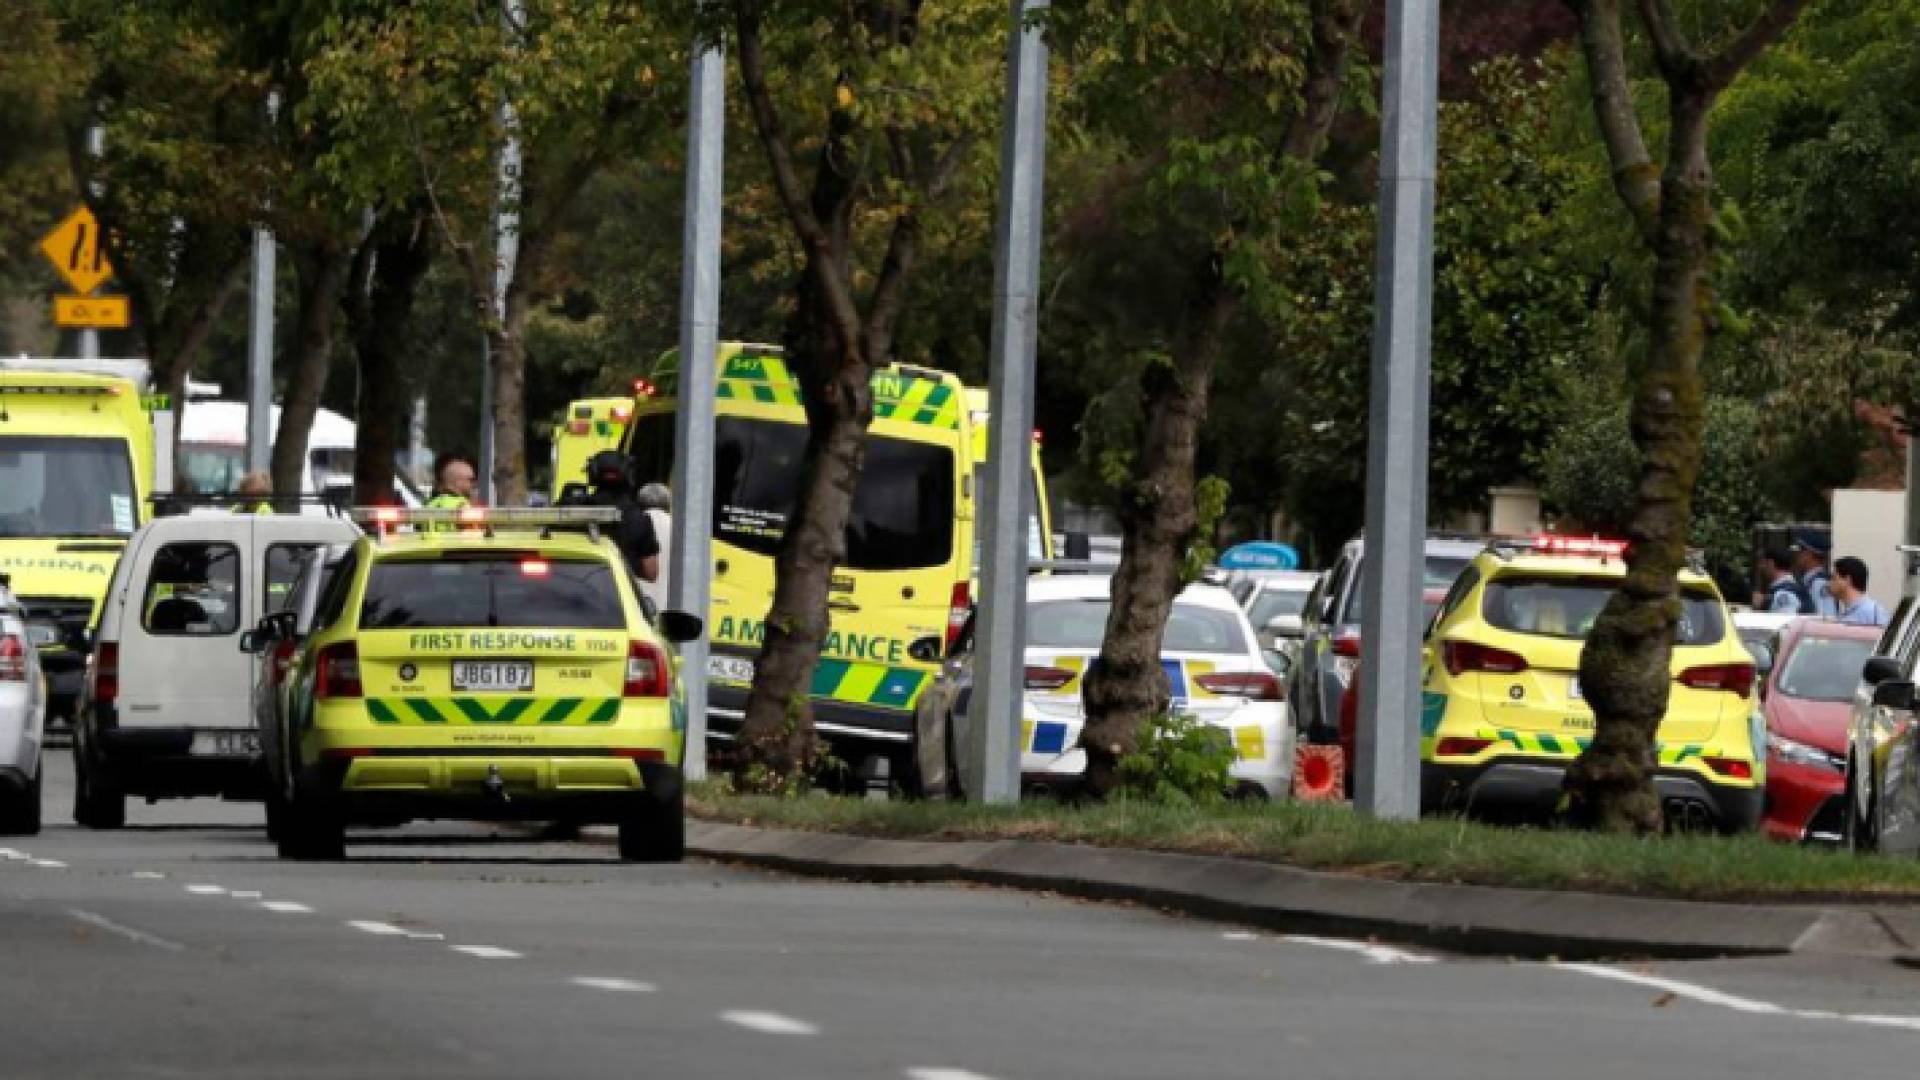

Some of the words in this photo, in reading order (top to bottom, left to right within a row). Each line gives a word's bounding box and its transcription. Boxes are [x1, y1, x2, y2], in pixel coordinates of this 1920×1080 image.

[409, 634, 464, 650] FIRST
[470, 634, 576, 651] RESPONSE
[456, 664, 530, 684] JBG187
